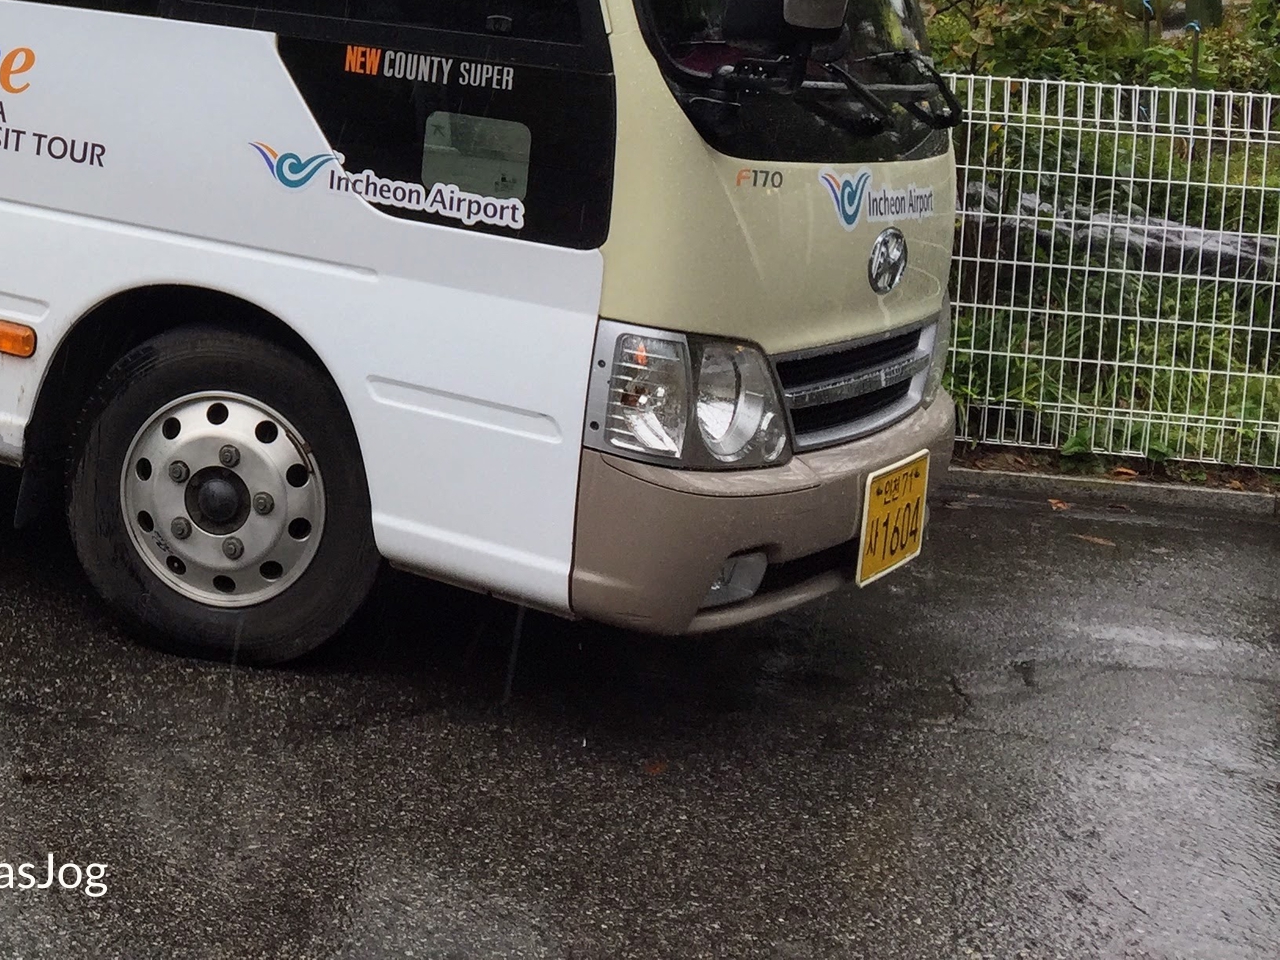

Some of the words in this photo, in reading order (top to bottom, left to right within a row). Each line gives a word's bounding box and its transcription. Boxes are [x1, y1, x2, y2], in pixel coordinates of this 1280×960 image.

[344, 44, 381, 76] NEW
[383, 50, 453, 85] COUNTY
[459, 62, 514, 90] SUPER
[32, 132, 106, 168] TOUR
[328, 169, 421, 206] Incheon
[429, 189, 521, 221] Airport
[735, 168, 783, 188] F170
[868, 189, 906, 217] Incheon
[908, 188, 934, 218] Airport
